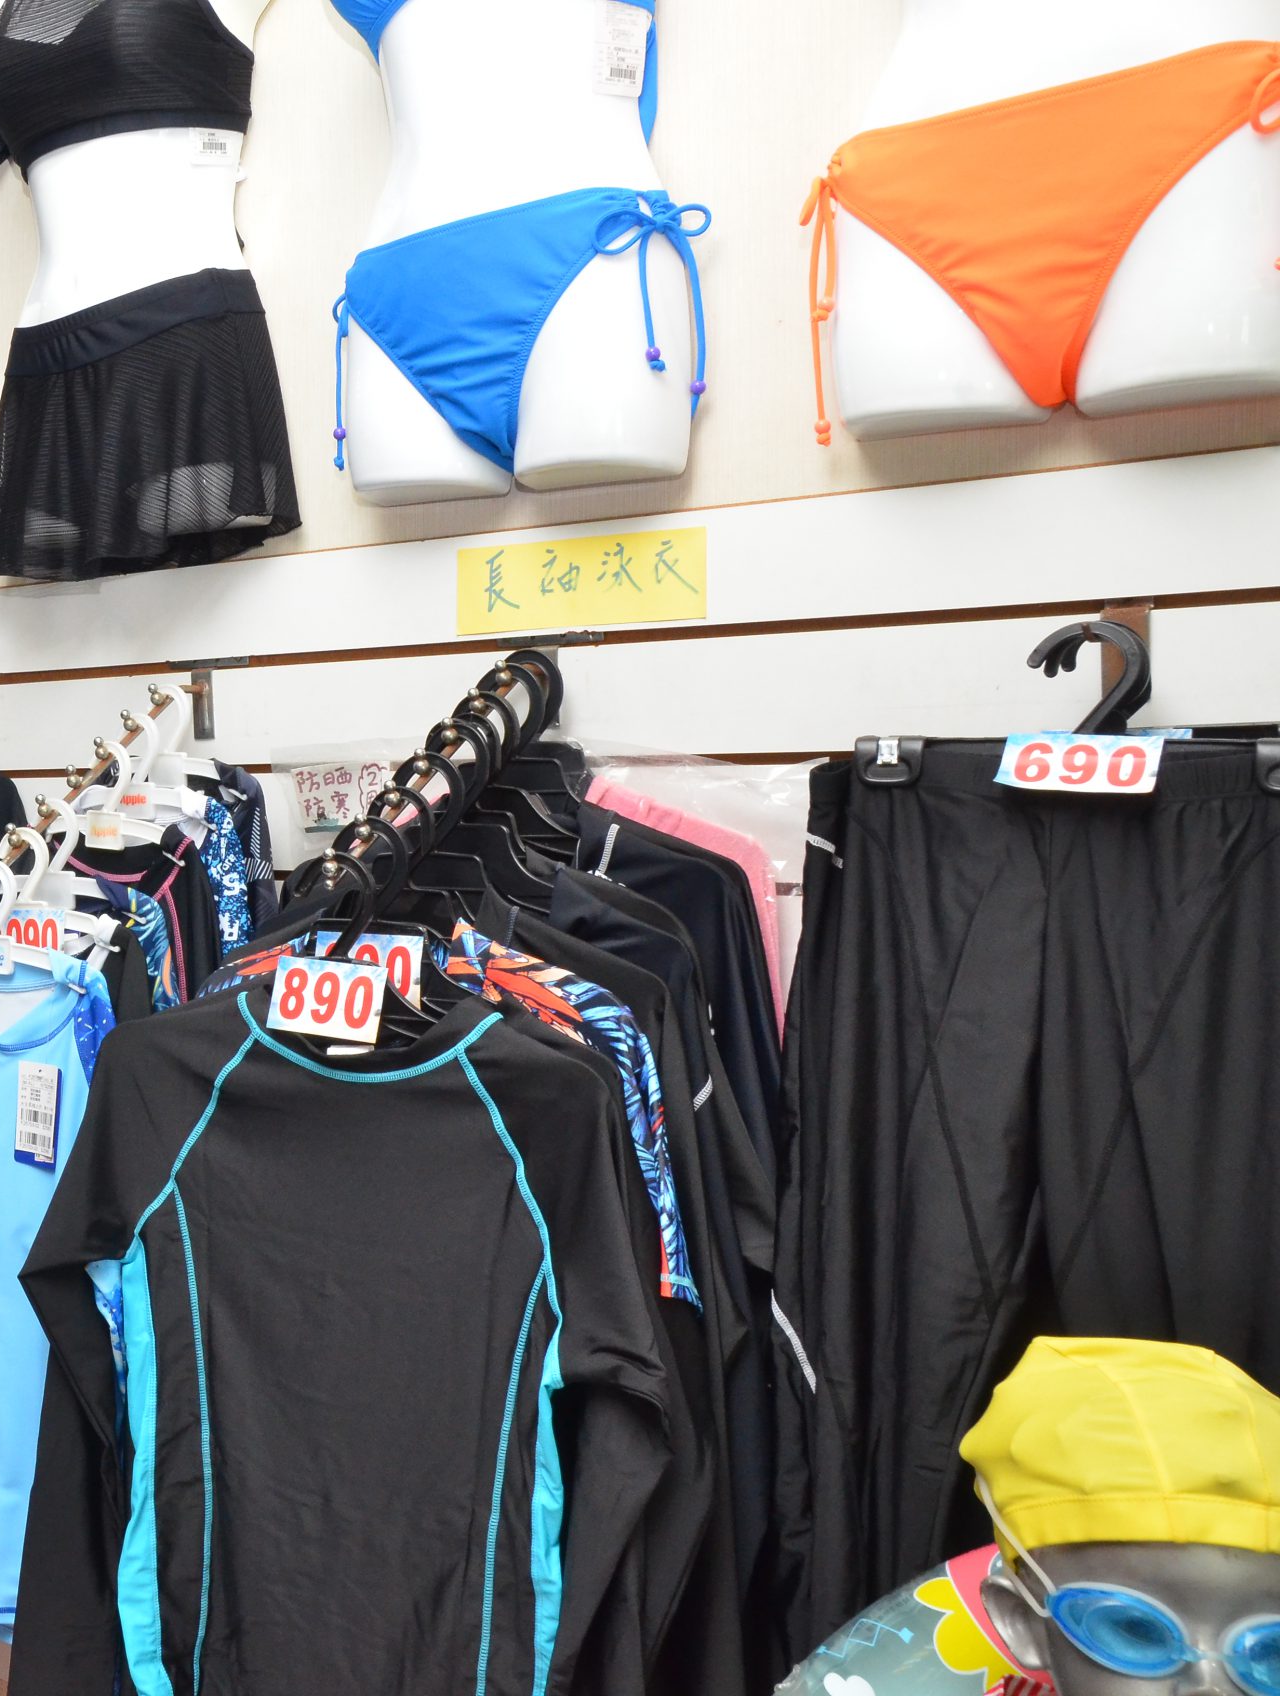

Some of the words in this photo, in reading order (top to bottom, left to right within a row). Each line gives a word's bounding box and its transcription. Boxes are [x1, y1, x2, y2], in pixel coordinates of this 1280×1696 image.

[485, 539, 699, 613] 長袖泳衣
[1013, 742, 1147, 788] 690
[303, 791, 350, 819] 防寒
[278, 966, 375, 1030] 890
